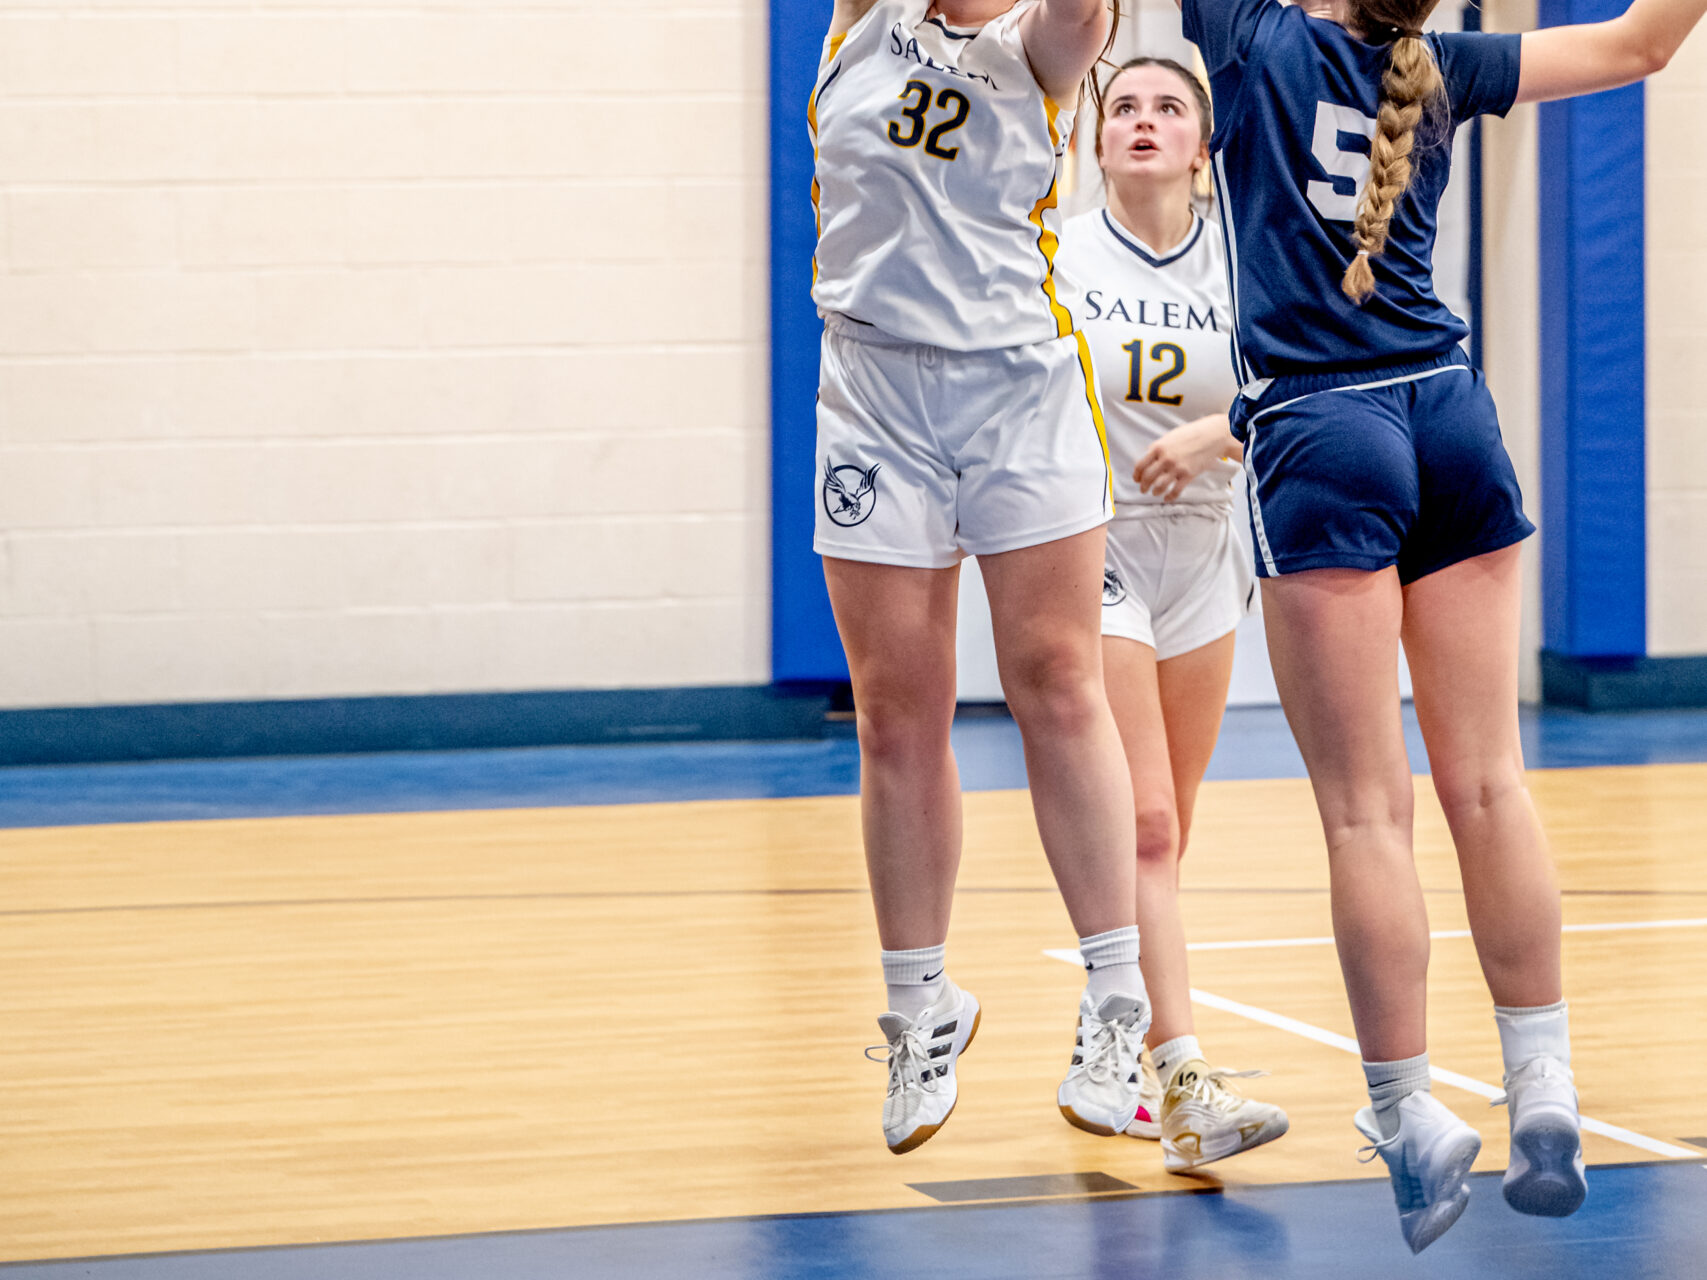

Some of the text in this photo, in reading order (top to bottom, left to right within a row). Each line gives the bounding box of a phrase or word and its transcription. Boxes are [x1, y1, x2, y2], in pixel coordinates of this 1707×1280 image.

[888, 79, 971, 161] 32
[1306, 100, 1378, 222] 5
[1085, 290, 1222, 333] SALEM
[1121, 338, 1187, 406] 12
